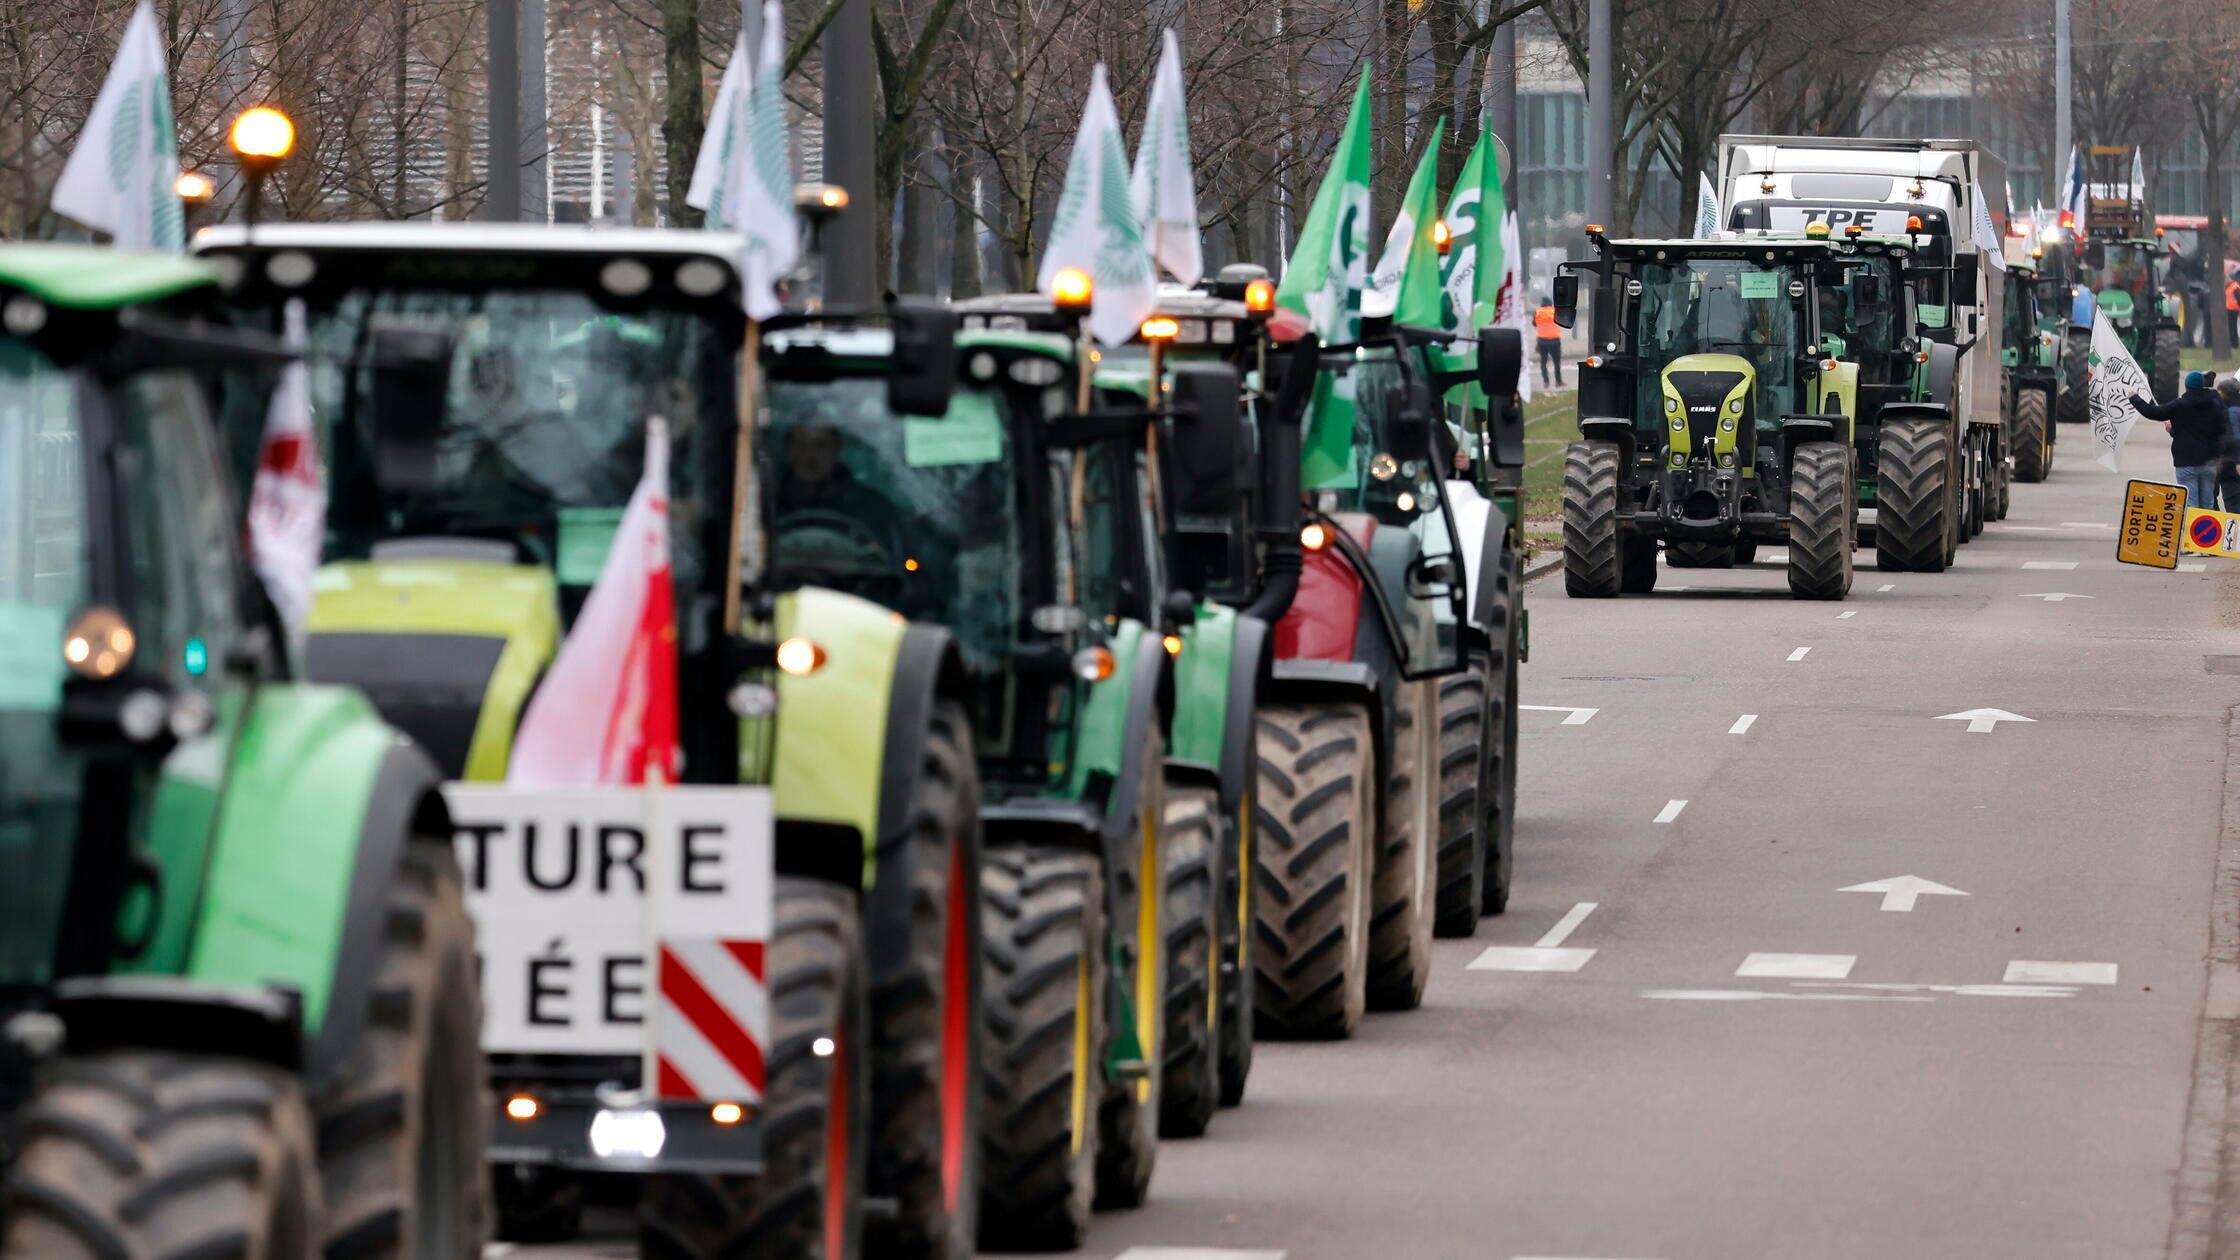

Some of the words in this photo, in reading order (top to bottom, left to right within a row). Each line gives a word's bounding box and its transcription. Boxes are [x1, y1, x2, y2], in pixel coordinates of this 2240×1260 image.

[1801, 209, 1877, 231] TPE
[2127, 495, 2145, 545] SORTIE
[2145, 514, 2158, 532] DE
[2158, 492, 2177, 557] CAMIONS
